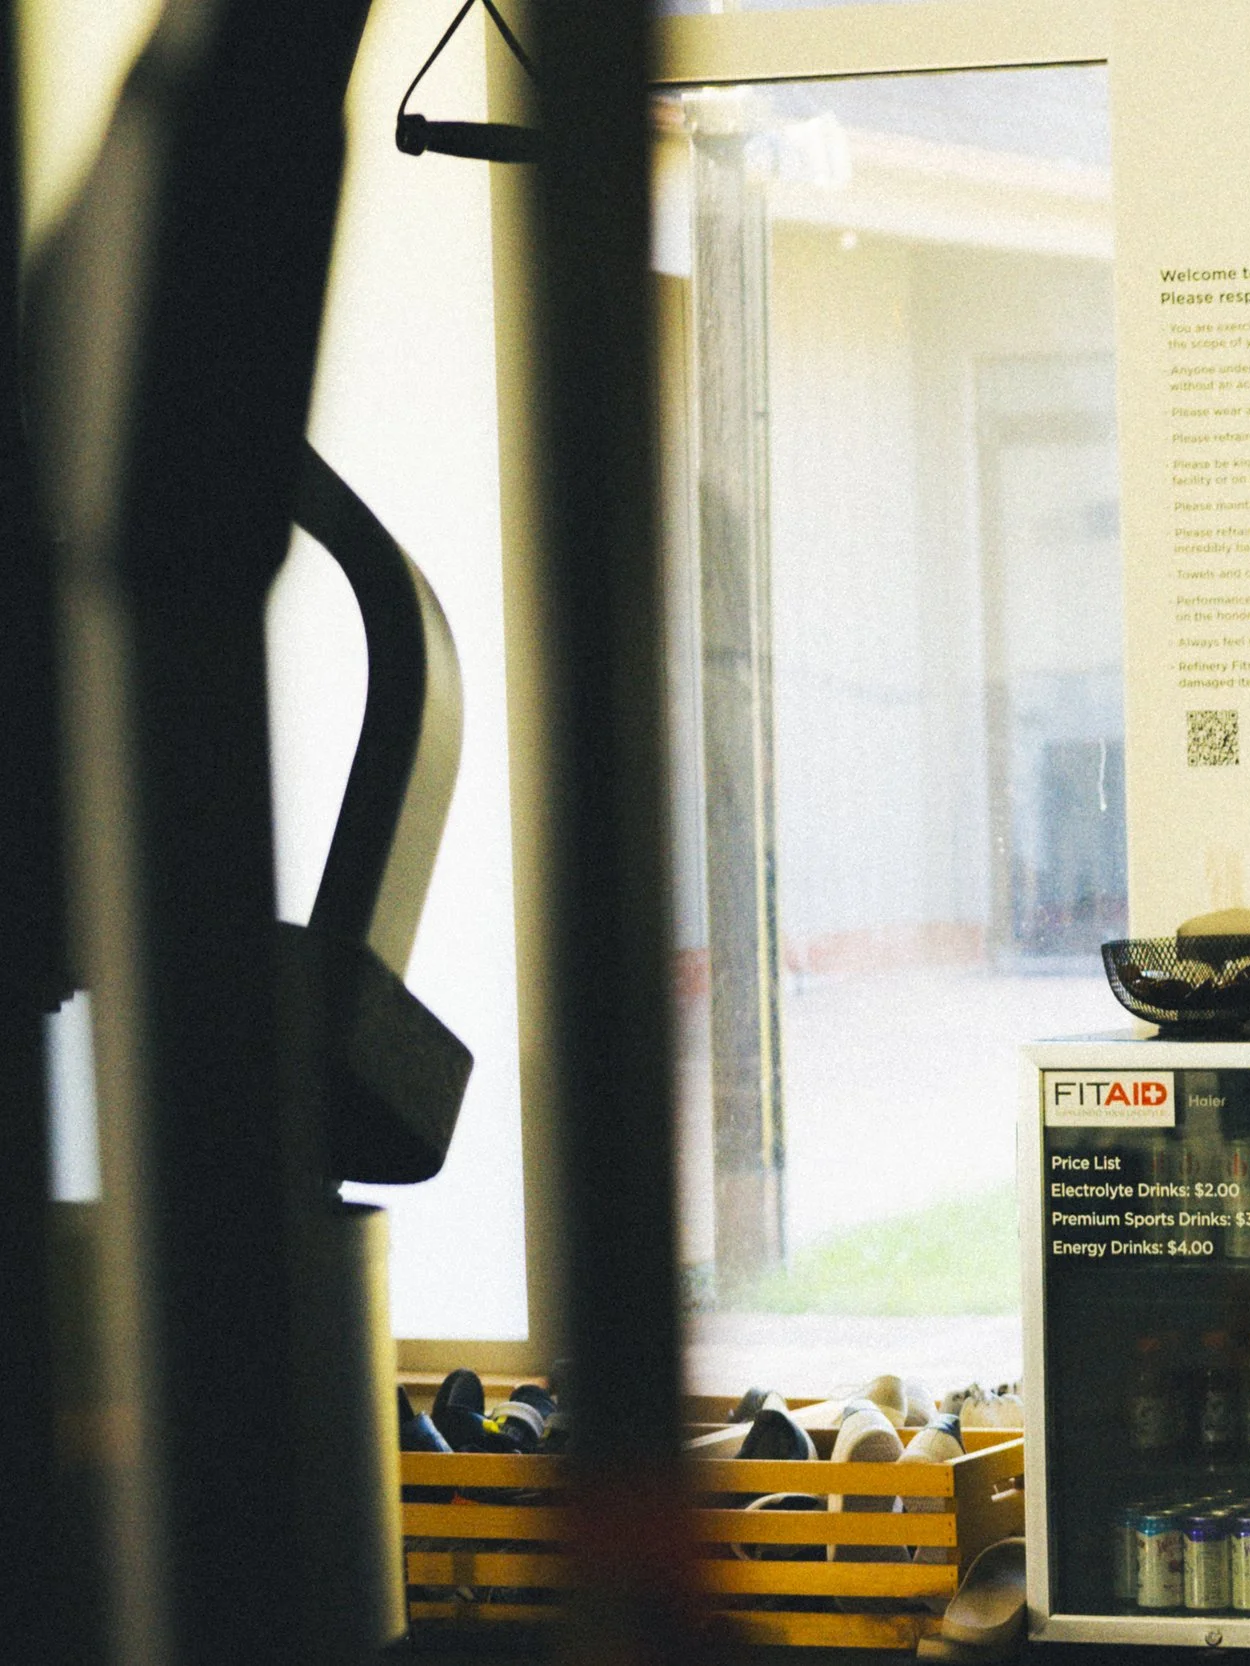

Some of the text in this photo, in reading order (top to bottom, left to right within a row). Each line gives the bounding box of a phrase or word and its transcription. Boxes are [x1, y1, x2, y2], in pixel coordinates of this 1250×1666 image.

[1160, 268, 1236, 282] Welcome
[1160, 292, 1213, 304] Please
[1171, 324, 1191, 333] You
[1195, 324, 1213, 332] are
[1168, 340, 1187, 348] the
[1191, 340, 1226, 350] scope
[1230, 337, 1242, 347] of
[1170, 366, 1215, 376] Anyone
[1170, 381, 1214, 391] without
[1219, 381, 1232, 390] an
[1171, 406, 1210, 417] Please
[1214, 407, 1241, 416] wear
[1172, 433, 1210, 443] Please
[1213, 432, 1250, 442] refrain
[1173, 460, 1210, 469] Please
[1214, 459, 1229, 468] be
[1172, 475, 1211, 486] facility
[1215, 476, 1228, 485] or
[1231, 476, 1246, 485] on
[1174, 501, 1212, 511] Please
[1175, 528, 1212, 537] Please
[1219, 569, 1241, 578] and
[1176, 613, 1191, 622] on
[1194, 612, 1212, 621] the
[1216, 611, 1250, 621] honor
[1178, 637, 1219, 648] Always
[1222, 636, 1245, 646] feel
[1178, 661, 1227, 673] Refinery
[1178, 678, 1234, 689] damaged
[1054, 1081, 1168, 1107] FITAID
[1187, 1094, 1226, 1108] Haier
[1051, 1156, 1121, 1170] Price List
[1051, 1182, 1240, 1200] Electrolyte Drinks: $2.00
[1052, 1212, 1121, 1227] Premium
[1124, 1212, 1175, 1229] Sports
[1179, 1211, 1231, 1226] Drinks:
[1053, 1239, 1214, 1257] Energy Drinks: $4.00
